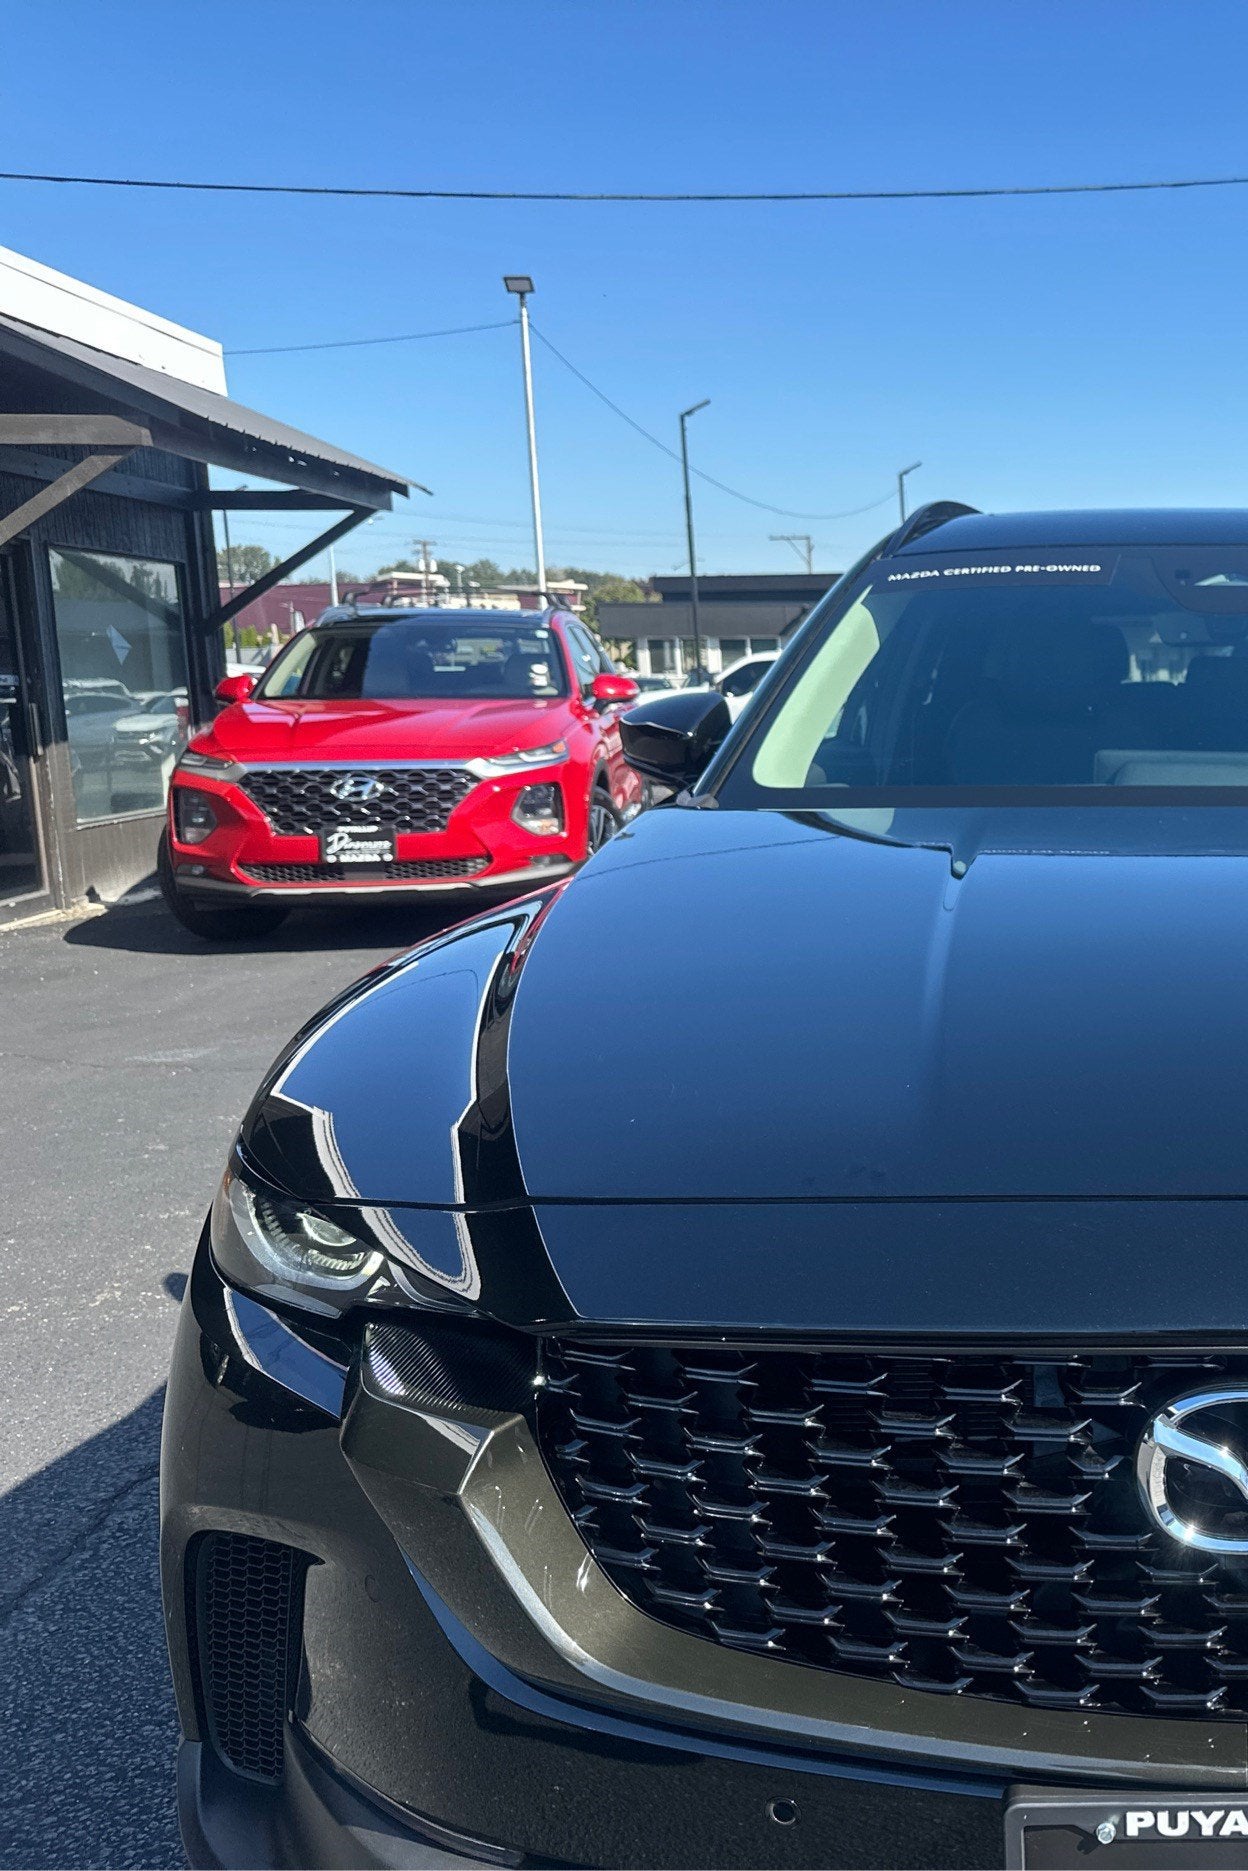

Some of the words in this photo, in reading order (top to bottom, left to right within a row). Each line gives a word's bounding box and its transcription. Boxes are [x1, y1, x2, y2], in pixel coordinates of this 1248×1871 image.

[887, 570, 940, 582] MAZDA
[943, 565, 1012, 576] CERTIFIED
[1015, 564, 1102, 573] PRE-OWNED
